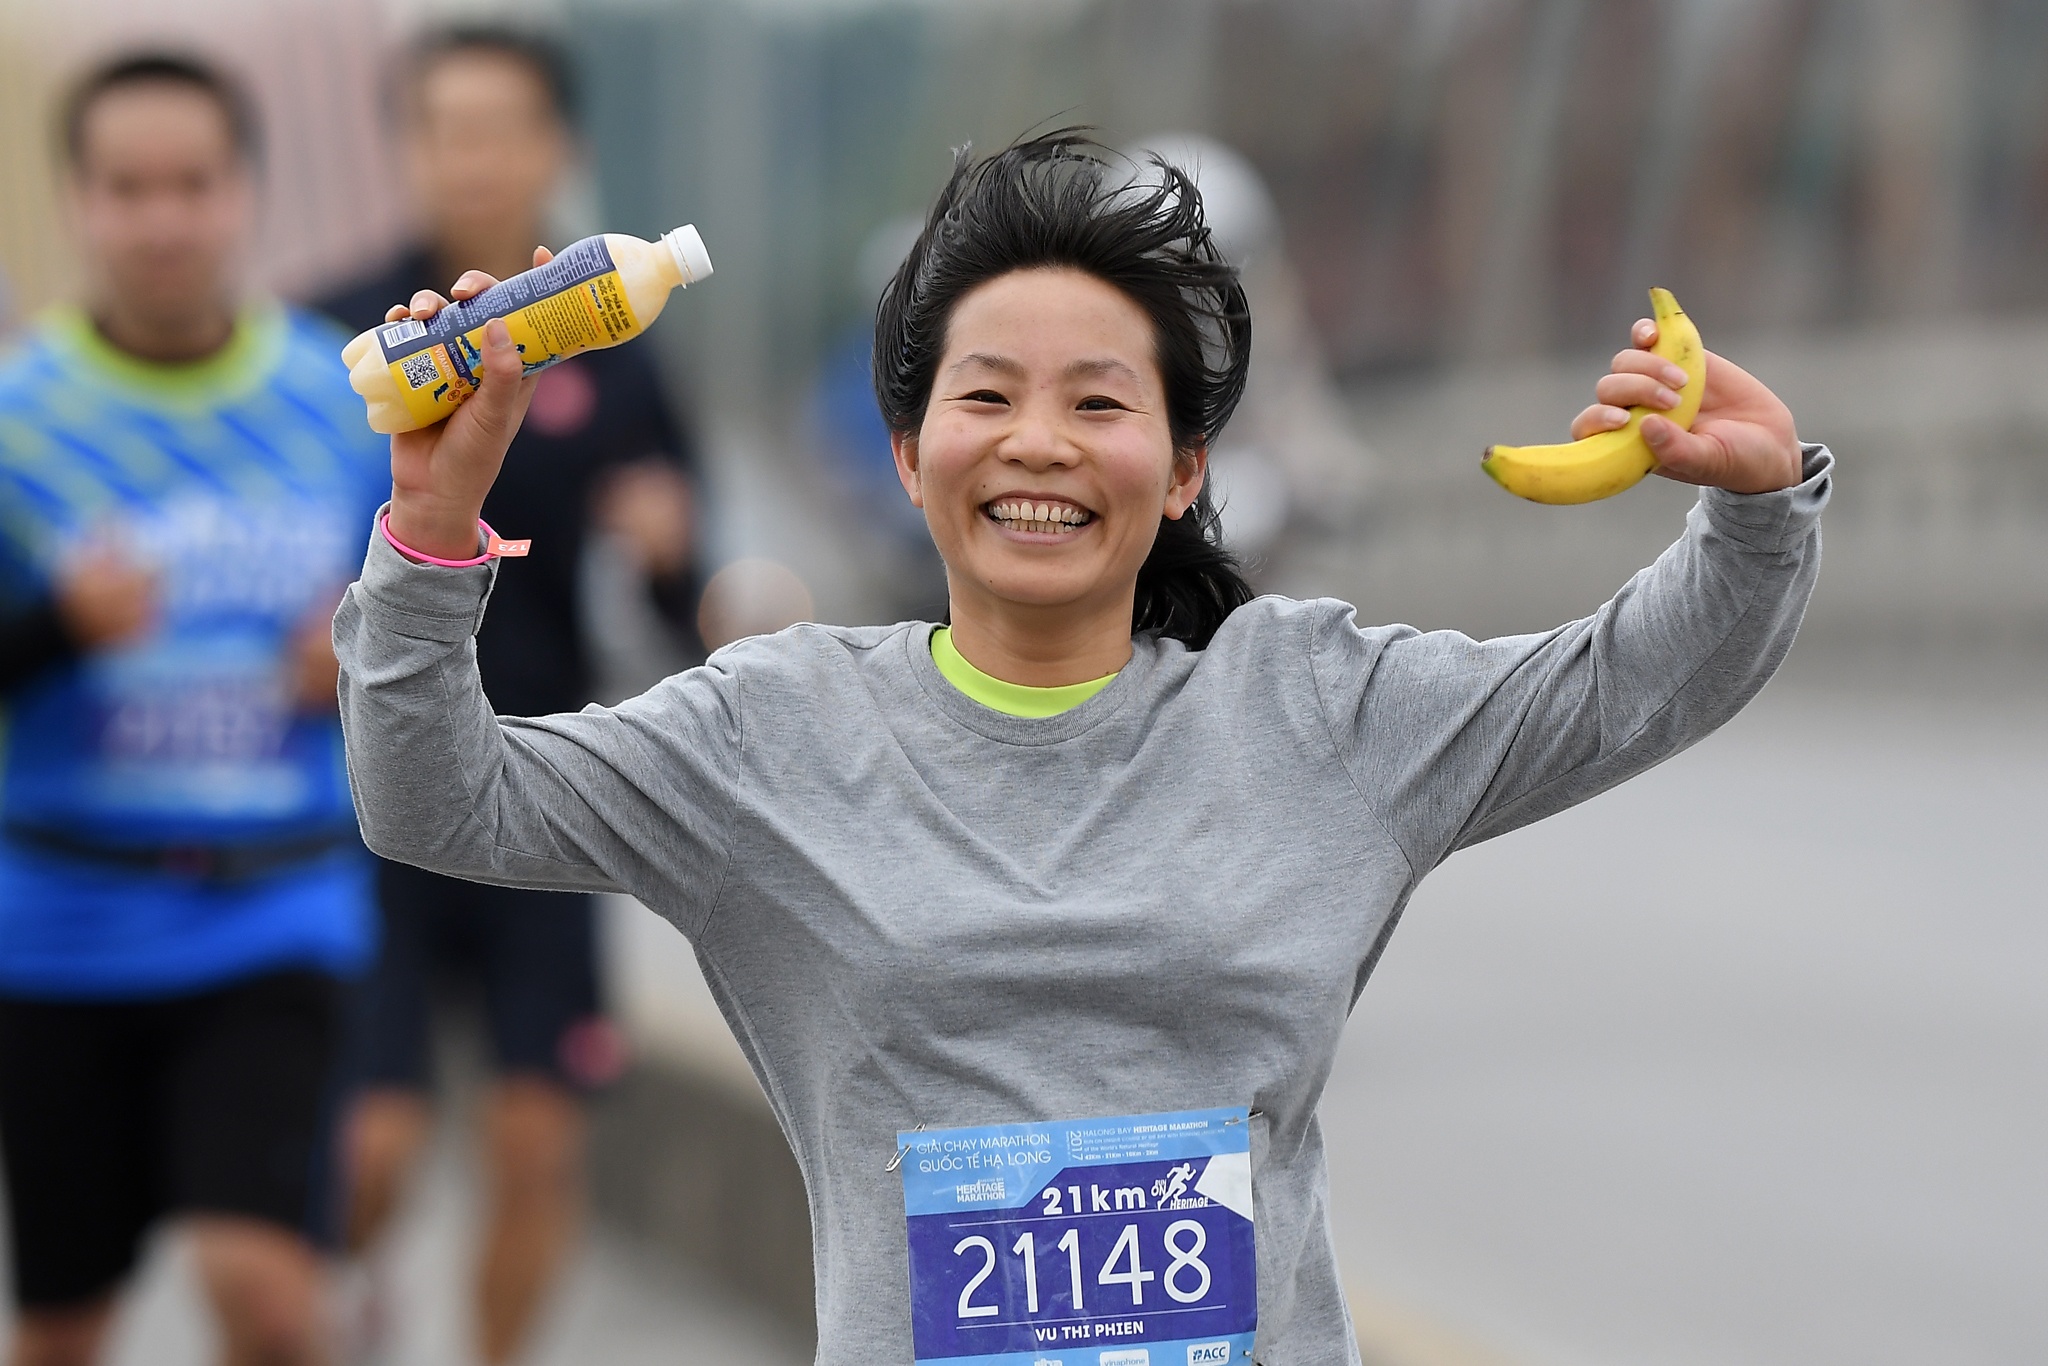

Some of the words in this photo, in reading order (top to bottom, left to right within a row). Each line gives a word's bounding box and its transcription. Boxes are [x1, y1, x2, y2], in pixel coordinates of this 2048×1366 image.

[435, 348, 455, 380] VITAMINS
[448, 343, 466, 374] ELECTROLYTES
[1083, 1128, 1116, 1137] HALONG
[1117, 1127, 1132, 1135] BAY
[1133, 1124, 1168, 1134] HERITAGE
[1169, 1120, 1208, 1131] MARATHON
[917, 1139, 941, 1154] GIẢI
[944, 1138, 977, 1153] CHẠY
[980, 1133, 1050, 1149] MARATHON
[1070, 1130, 1083, 1161] 2017
[920, 1154, 963, 1173] QUỐC
[966, 1151, 980, 1169] TẾ
[984, 1154, 1003, 1170] HẠ
[1008, 1150, 1051, 1166] LONG
[956, 1181, 1005, 1195] HERITAGE
[957, 1191, 1006, 1203] MARATHON
[1151, 1184, 1167, 1197] ON
[1042, 1184, 1146, 1215] 21km
[1170, 1197, 1209, 1210] HERITAGE
[953, 1219, 1211, 1318] 21148
[1035, 1328, 1057, 1342] VU
[1061, 1325, 1091, 1340] THI
[1095, 1321, 1144, 1337] PHIEN
[1104, 1357, 1146, 1366] vinaphone
[1203, 1346, 1226, 1360] ACC
